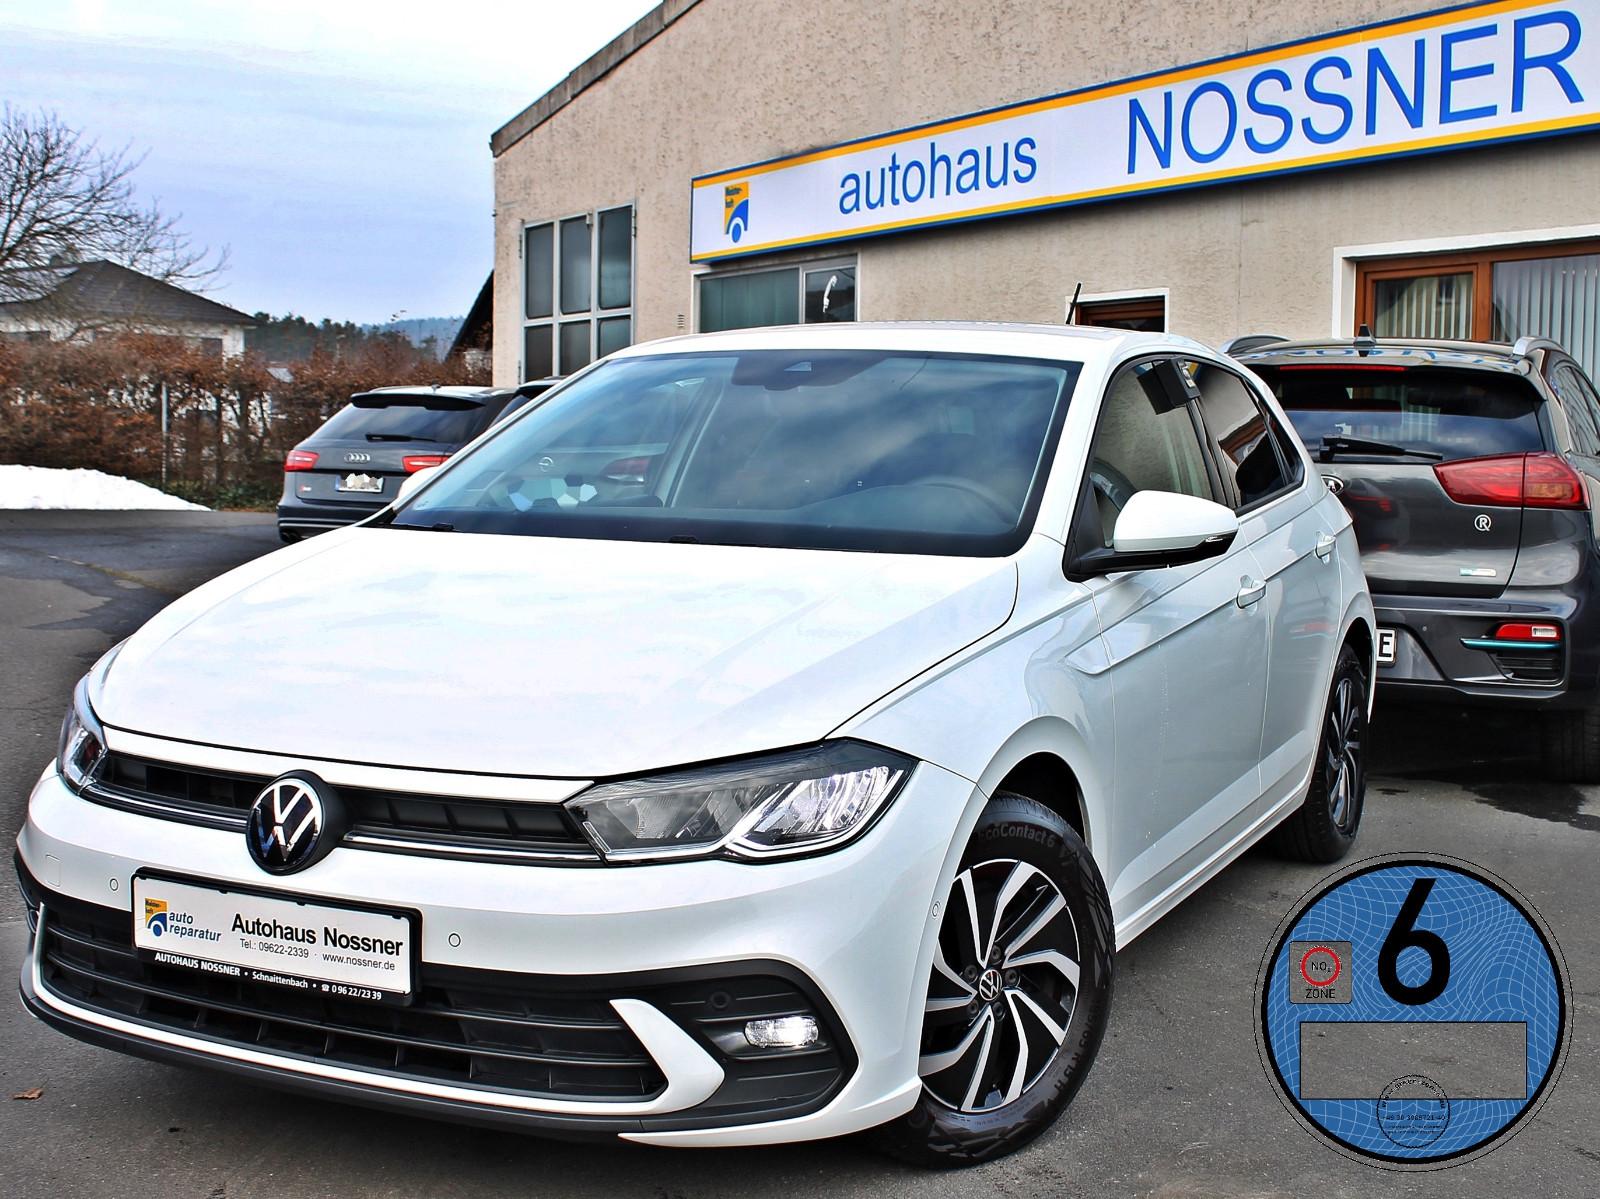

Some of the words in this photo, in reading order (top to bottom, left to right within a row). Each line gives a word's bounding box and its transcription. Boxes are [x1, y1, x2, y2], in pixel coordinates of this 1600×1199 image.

[839, 136, 1037, 214] autohaus
[1127, 10, 1585, 174] NOSSNER
[168, 911, 194, 925] auto
[169, 924, 222, 942] reparatur
[232, 913, 317, 944] Autohaus
[323, 926, 403, 956] Nossner
[155, 952, 199, 969] AUTOHAUS
[201, 961, 241, 977] NOSSNER
[252, 971, 309, 988] Schnaittenbach
[240, 938, 257, 950] Tel.:
[258, 941, 309, 958] 09622-2339
[322, 953, 395, 971] www.nossner.de
